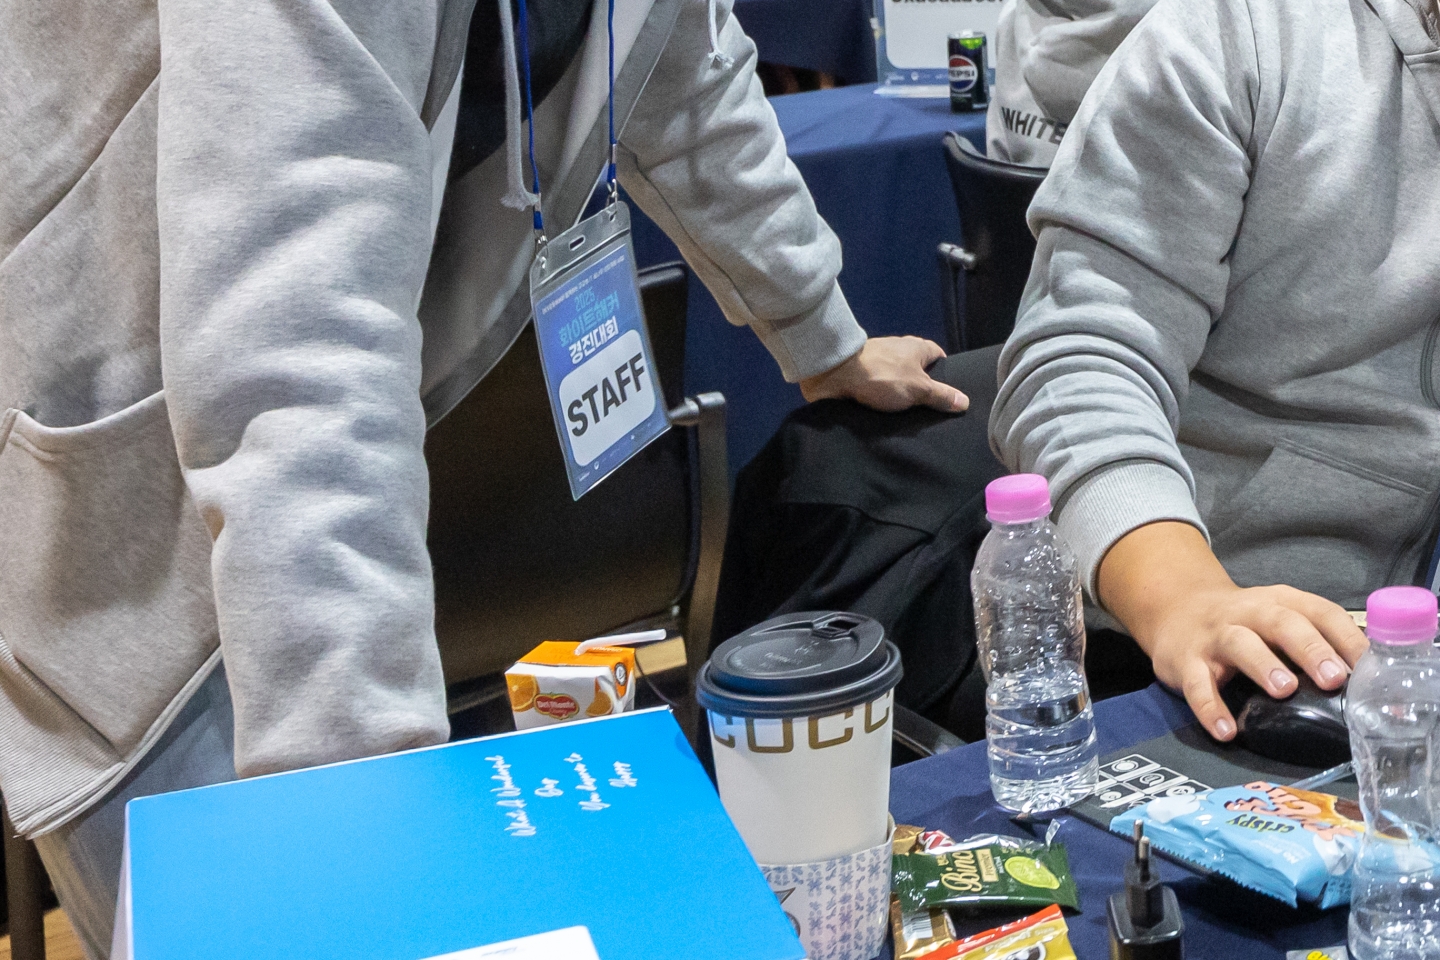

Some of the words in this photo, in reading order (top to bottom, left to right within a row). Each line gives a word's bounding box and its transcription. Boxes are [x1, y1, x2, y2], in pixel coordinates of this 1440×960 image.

[1001, 106, 1067, 146] WHITE
[558, 289, 620, 349] 화이트해커
[573, 287, 597, 313] 2025
[568, 316, 619, 364] 경진대회
[566, 352, 645, 437] STAFF
[1225, 813, 1296, 834] crispy
